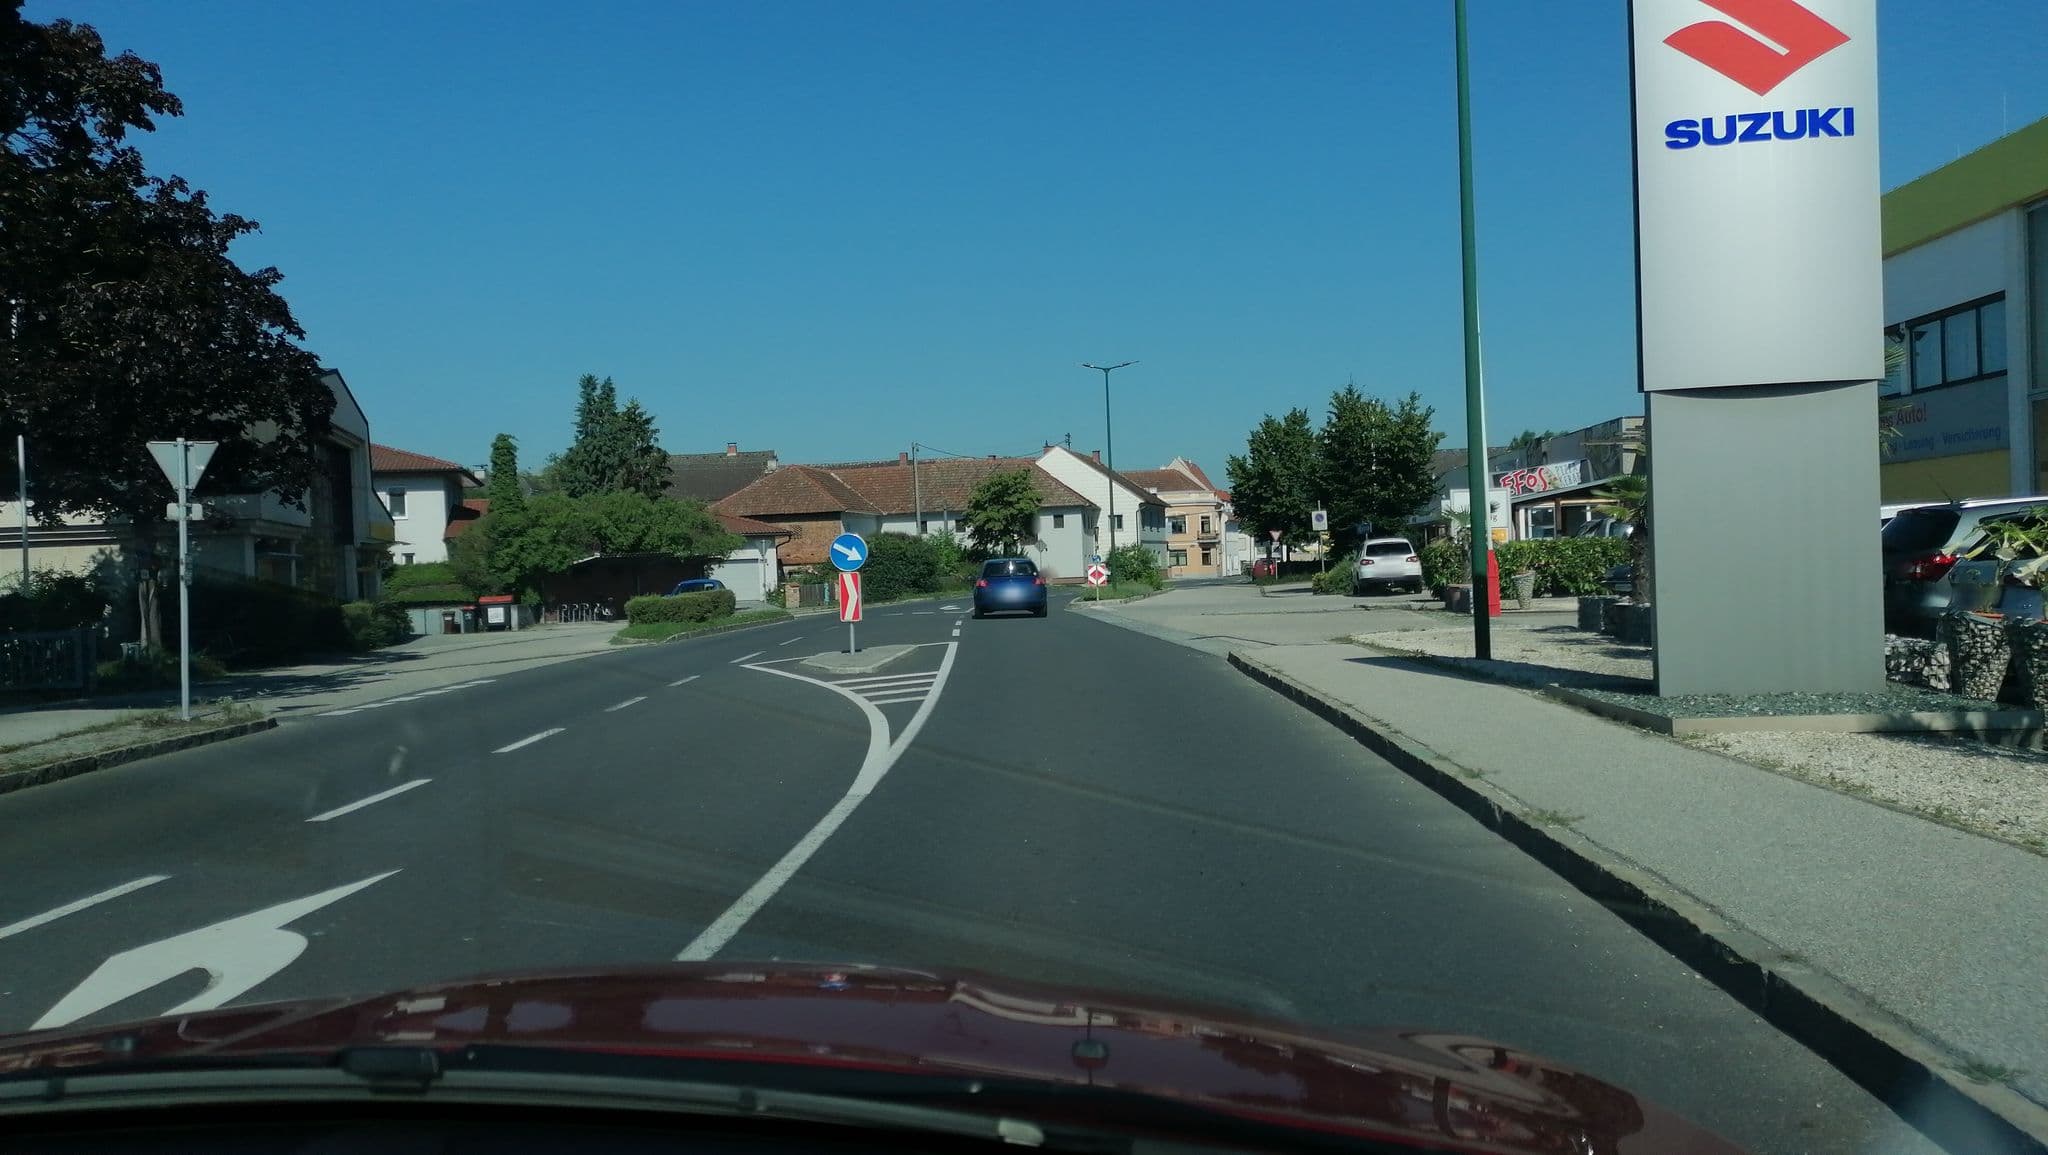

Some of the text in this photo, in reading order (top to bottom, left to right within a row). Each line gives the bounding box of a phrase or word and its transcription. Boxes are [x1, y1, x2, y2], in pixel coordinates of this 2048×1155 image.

[1665, 107, 1854, 149] SUZUKI
[1896, 401, 1927, 426] Auto!
[1500, 466, 1549, 495] EFOS
